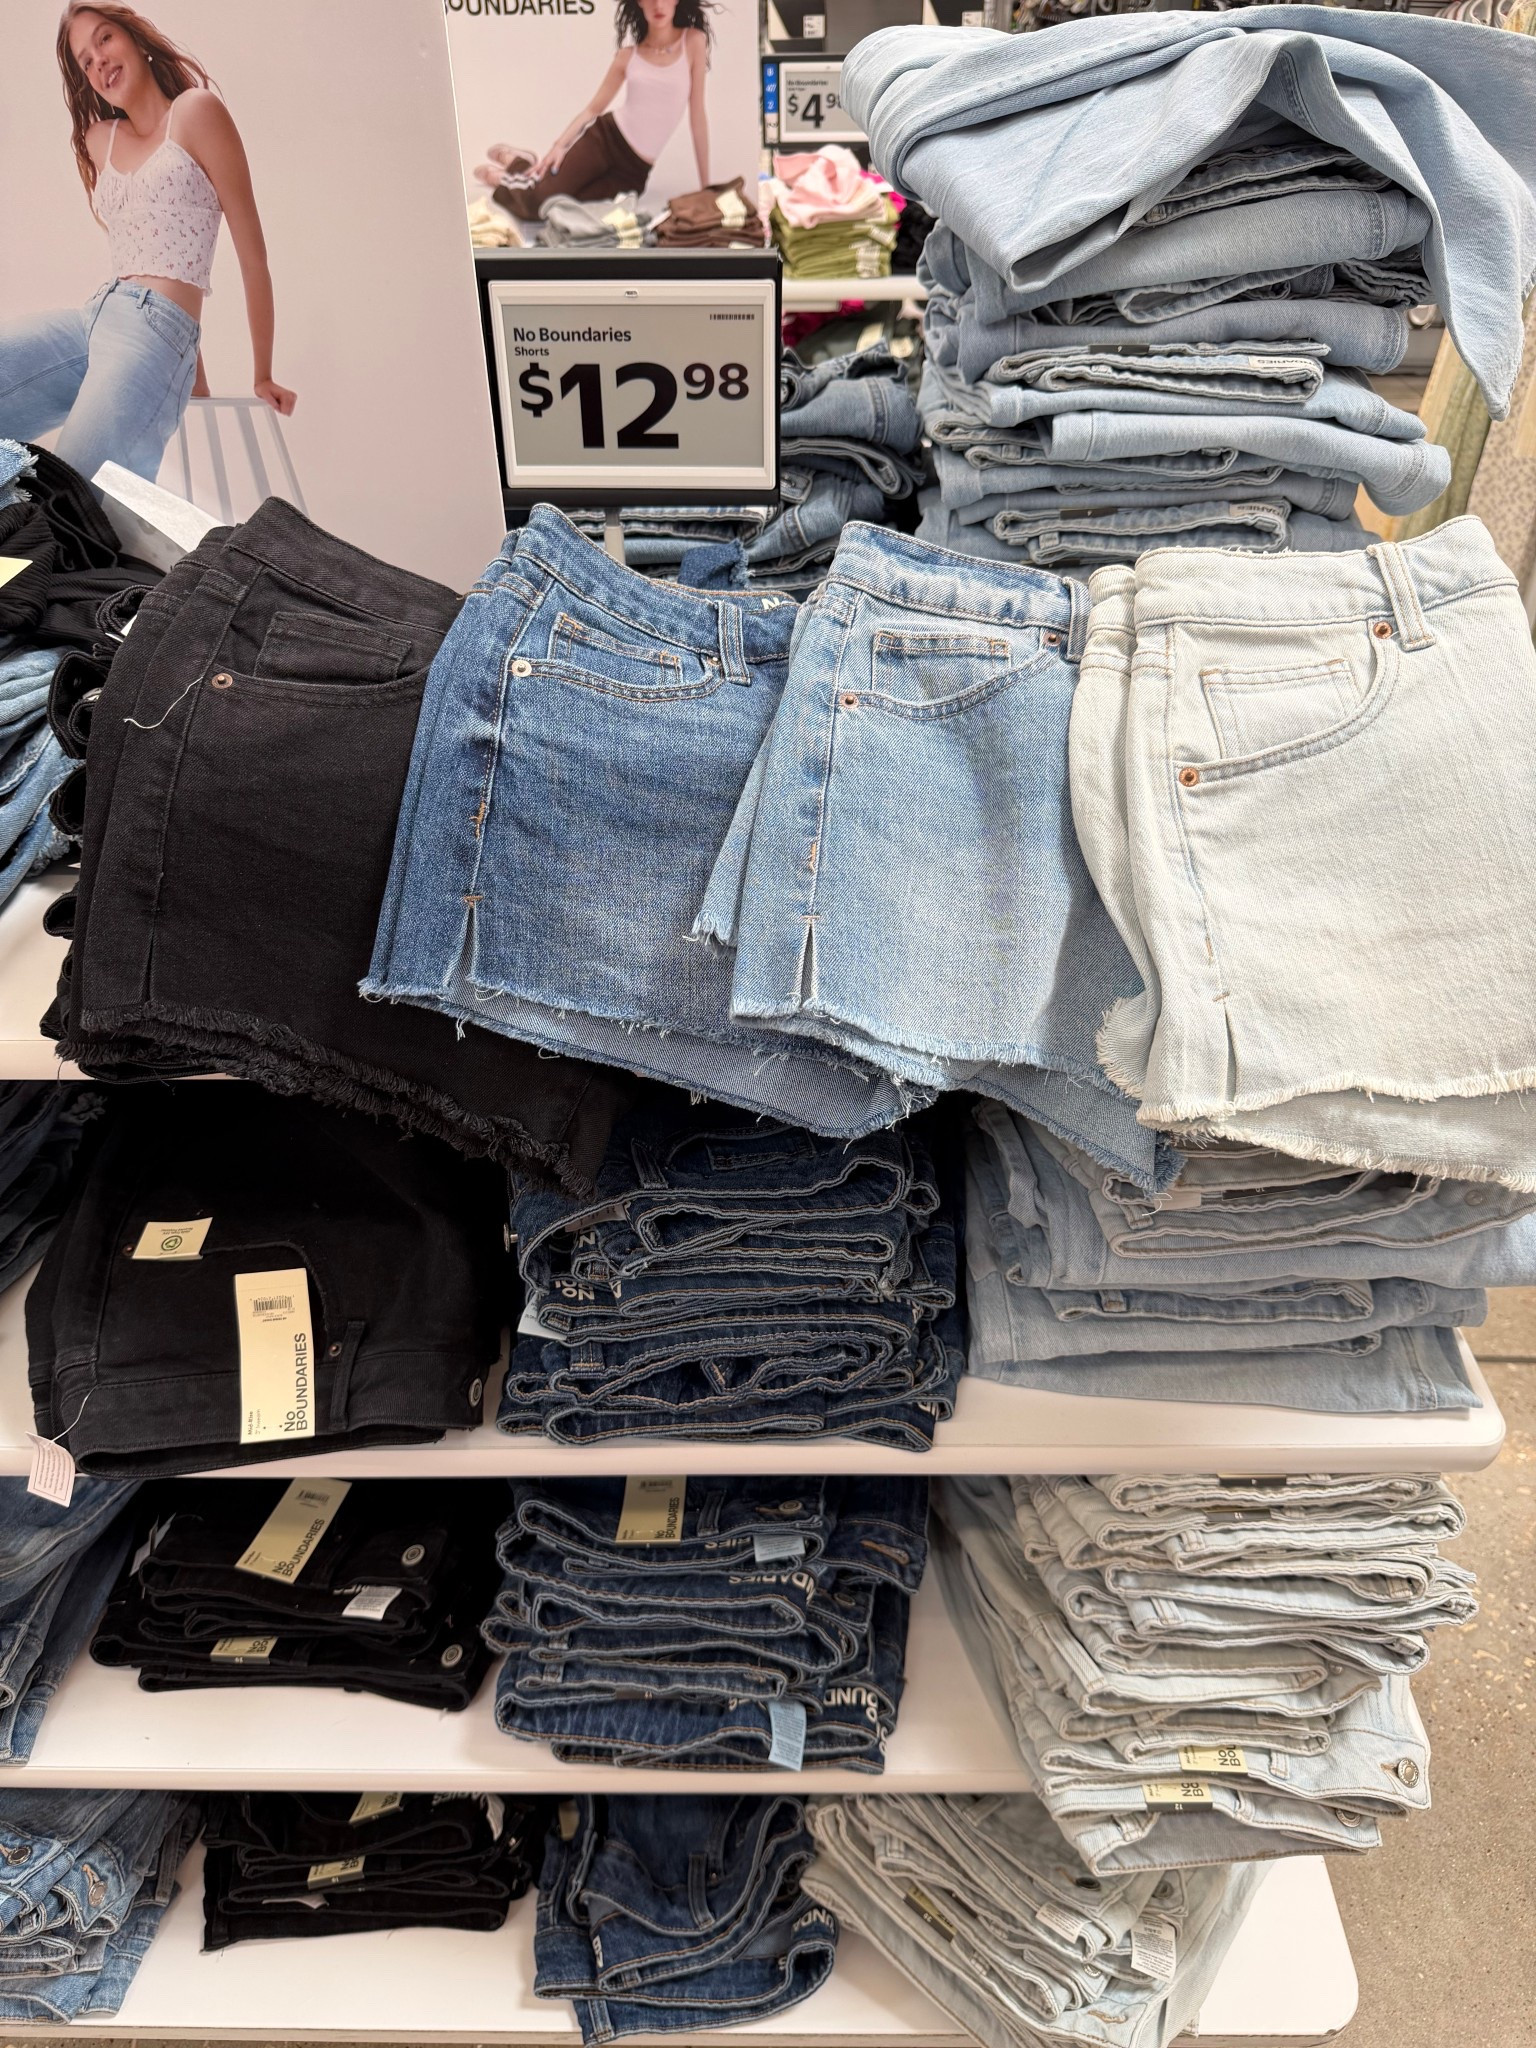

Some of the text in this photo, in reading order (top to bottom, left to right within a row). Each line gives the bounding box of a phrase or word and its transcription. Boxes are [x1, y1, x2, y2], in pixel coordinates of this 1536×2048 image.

[444, 0, 595, 16] OUNDARIES
[513, 327, 632, 342] No Boundaries
[514, 346, 550, 357] Shorts
[294, 1332, 308, 1431] BOUNDARIES
